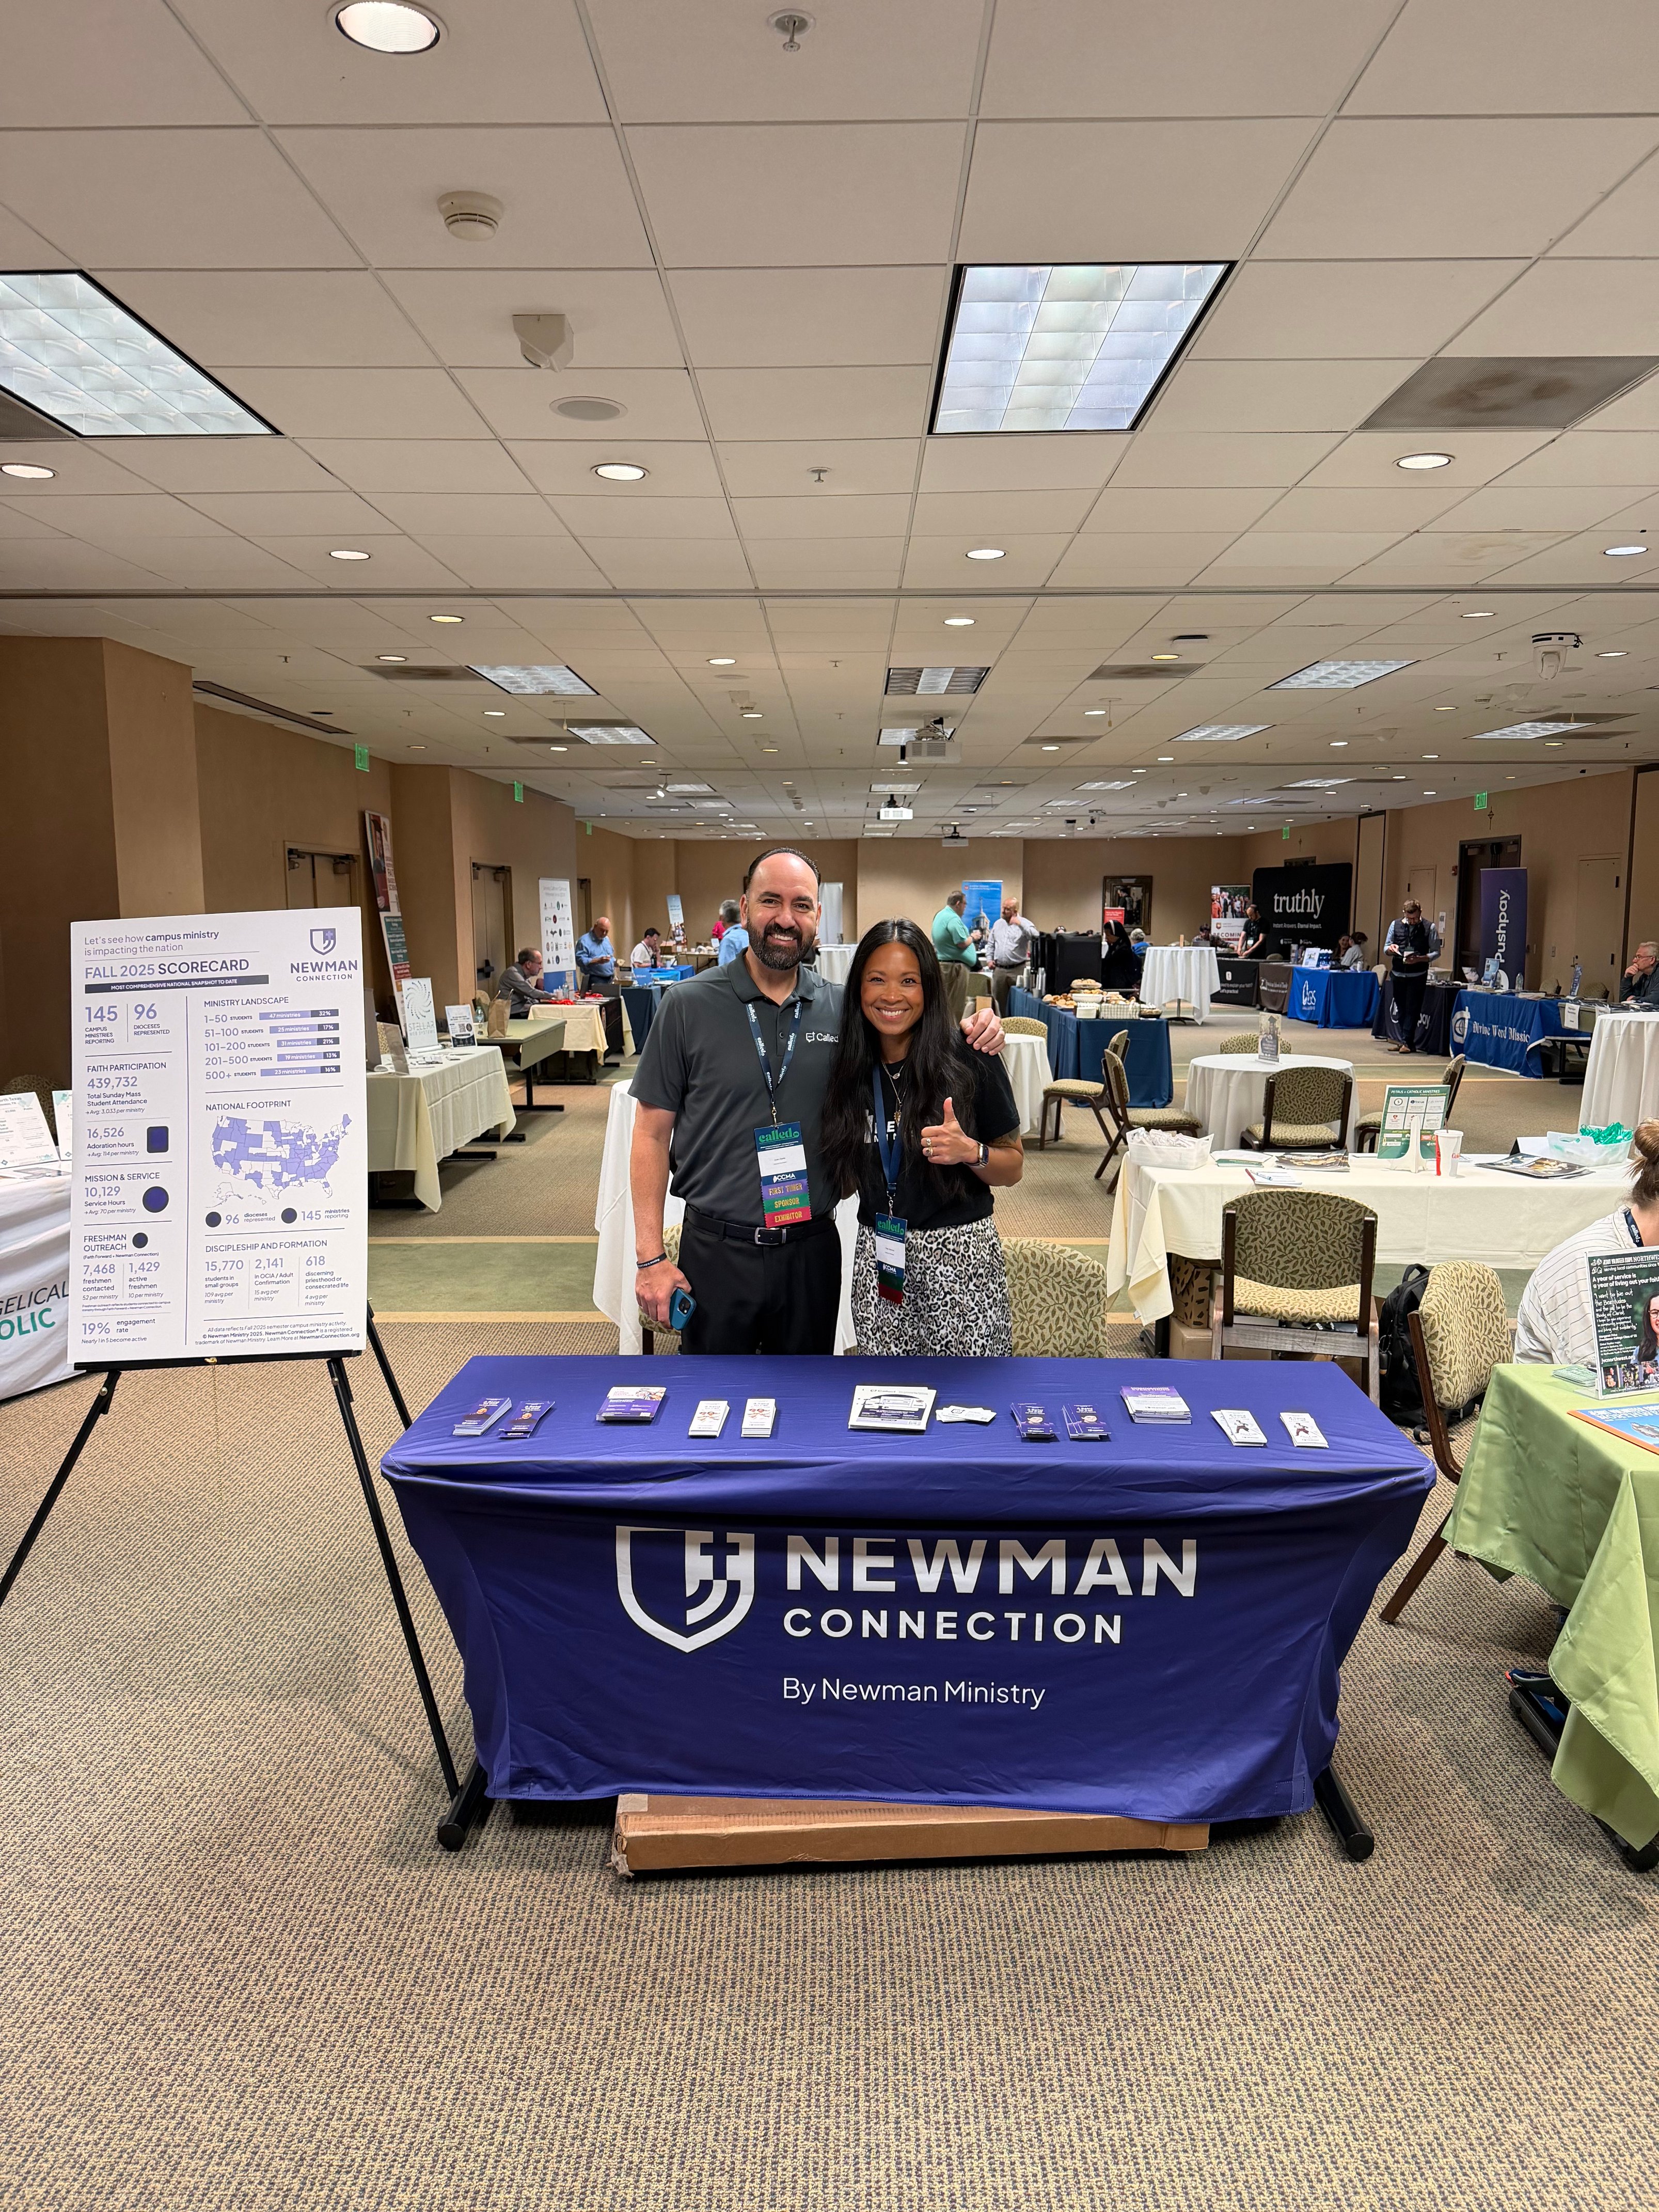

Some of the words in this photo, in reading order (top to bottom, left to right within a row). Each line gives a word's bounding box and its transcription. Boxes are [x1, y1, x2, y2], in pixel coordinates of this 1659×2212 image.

[1274, 889, 1324, 919] truthly
[1495, 890, 1510, 962] pushpay
[146, 933, 181, 942] campus
[183, 931, 218, 940] ministry
[93, 946, 137, 956] impacting
[85, 966, 117, 978] FALL
[120, 964, 155, 976] 2025
[158, 959, 249, 974] SCORECARD
[290, 960, 357, 973] NEWMAN
[242, 997, 289, 1005] LANDSCAPE
[85, 1006, 118, 1022] 145
[134, 1003, 157, 1020] 96
[1473, 1021, 1490, 1035] Divine
[1492, 1025, 1507, 1039] Word
[816, 1033, 839, 1042] Called
[110, 1062, 166, 1071] PARTICIPATION
[206, 1071, 231, 1079] 500+
[87, 1077, 137, 1089] 439,732
[247, 1100, 291, 1109] FOOTPRINT
[87, 1127, 124, 1139] 16,526
[85, 1186, 120, 1198] 10,129
[775, 1198, 799, 1208] SPONSOR
[225, 1214, 240, 1224] 96
[301, 1210, 321, 1221] 145
[775, 1212, 802, 1222] EXHIBITOR
[84, 1234, 127, 1242] FRESHMAN
[84, 1243, 127, 1252] OUTREACH
[206, 1243, 259, 1252] DISCIPLESHIP
[279, 1240, 327, 1249] FORMATION
[206, 1260, 244, 1272] 15,770
[255, 1258, 283, 1269] 2,141
[306, 1256, 325, 1266] 618
[84, 1264, 115, 1276] 7,468
[129, 1261, 160, 1274] 1,429
[83, 1322, 110, 1335] 19%
[787, 1535, 1197, 1598] NEWMAN
[783, 1607, 1121, 1644] CONNECTION
[783, 1677, 816, 1705] By
[822, 1678, 938, 1702] Newman
[944, 1681, 1046, 1711] Ministry
